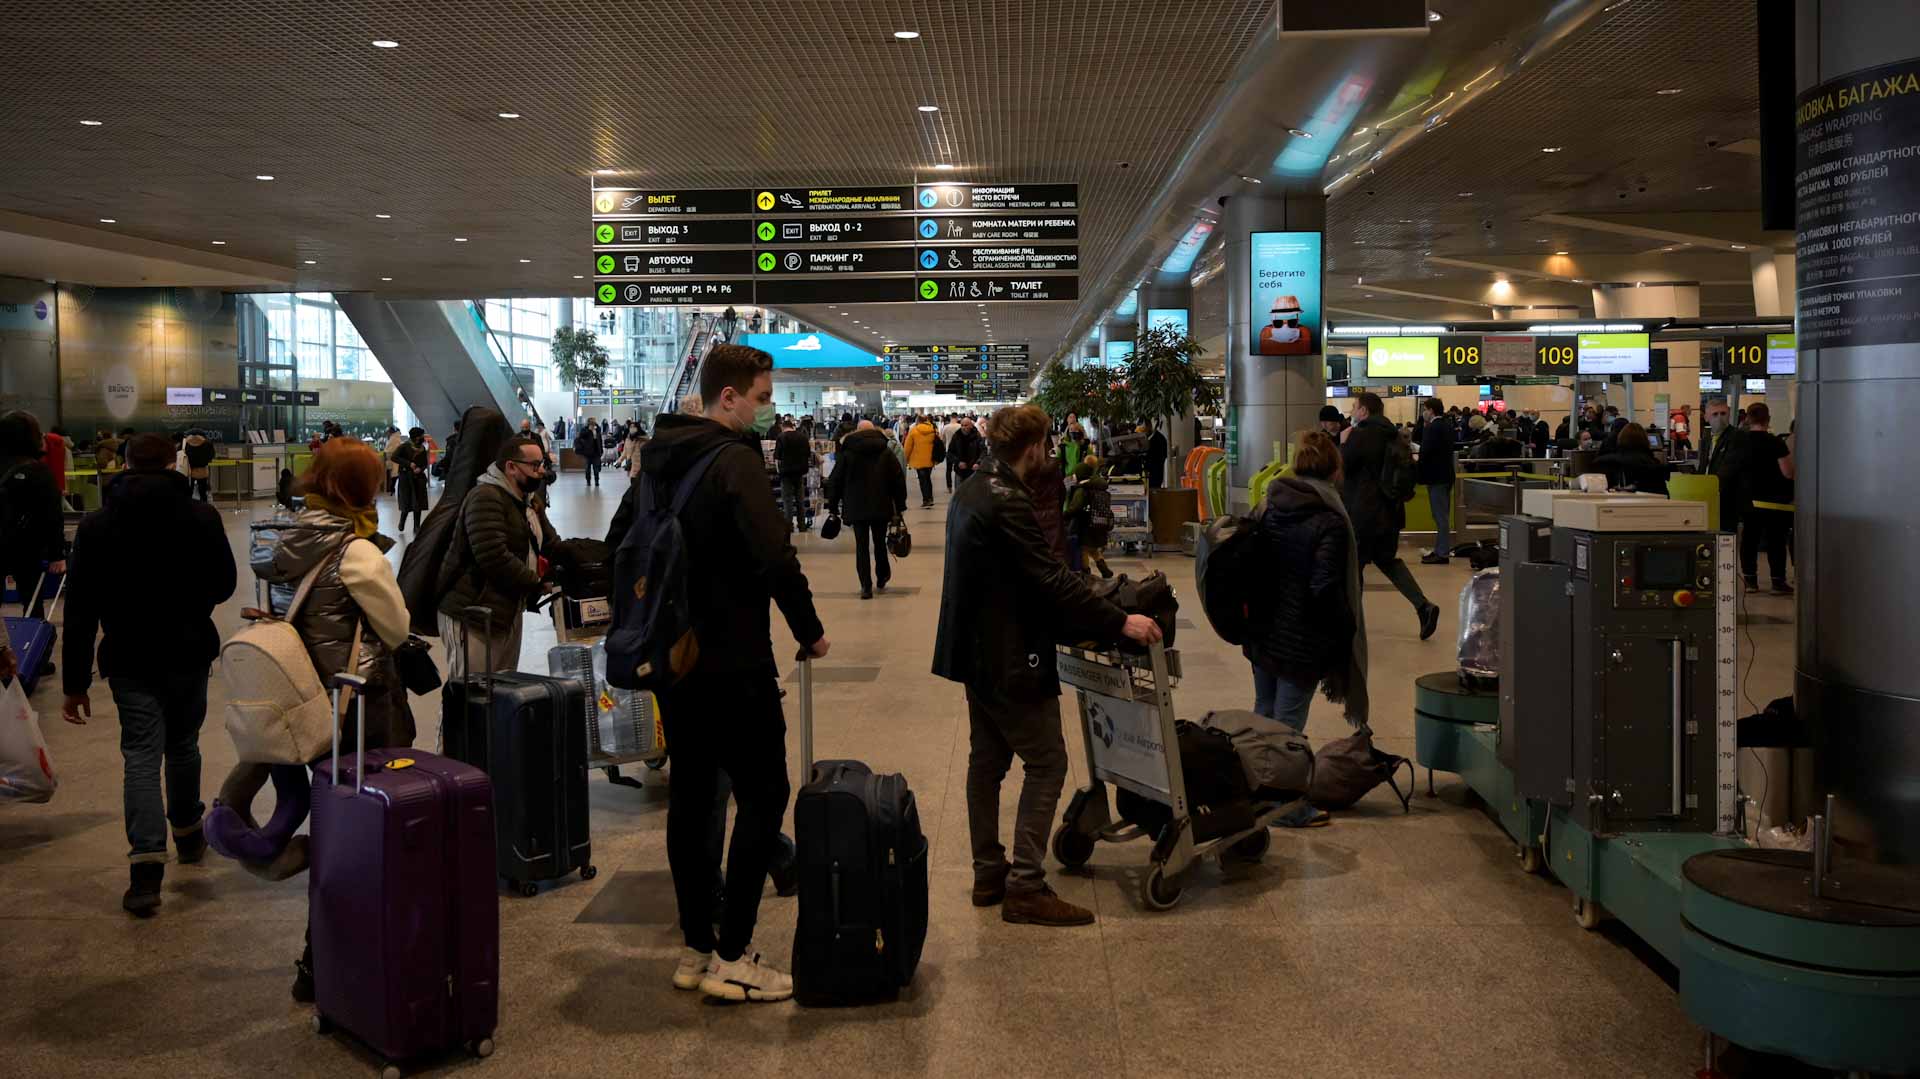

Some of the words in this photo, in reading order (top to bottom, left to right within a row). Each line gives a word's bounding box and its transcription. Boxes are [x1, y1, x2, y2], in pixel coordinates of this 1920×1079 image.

[1838, 72, 1920, 109] БАГАЖА
[1824, 108, 1882, 133] WRAPPING
[1834, 174, 1849, 187] 800
[1850, 165, 1889, 182] РУБЛЕЙ
[648, 195, 676, 204] ВЫЛЕТ
[648, 226, 679, 235] ВЫХОД
[683, 226, 688, 234] 3
[810, 224, 840, 233] ВЫХОД
[857, 223, 862, 232] 2
[1832, 237, 1852, 250] 1000
[1853, 230, 1893, 247] РУБЛЕЙ
[648, 256, 693, 264] АВТОБУСЫ
[810, 254, 850, 262] ПАРКИНГ
[1259, 270, 1306, 278] Берегите
[1010, 282, 1042, 290] ТУАЛЕТ
[1258, 280, 1282, 288] себя
[650, 285, 688, 294] ПАРКИНГ
[1856, 288, 1902, 299] УПАКОВКИ
[1443, 346, 1480, 365] 108
[1538, 346, 1574, 365] 109
[1728, 346, 1762, 364] 110
[1104, 674, 1126, 689] ONLY
